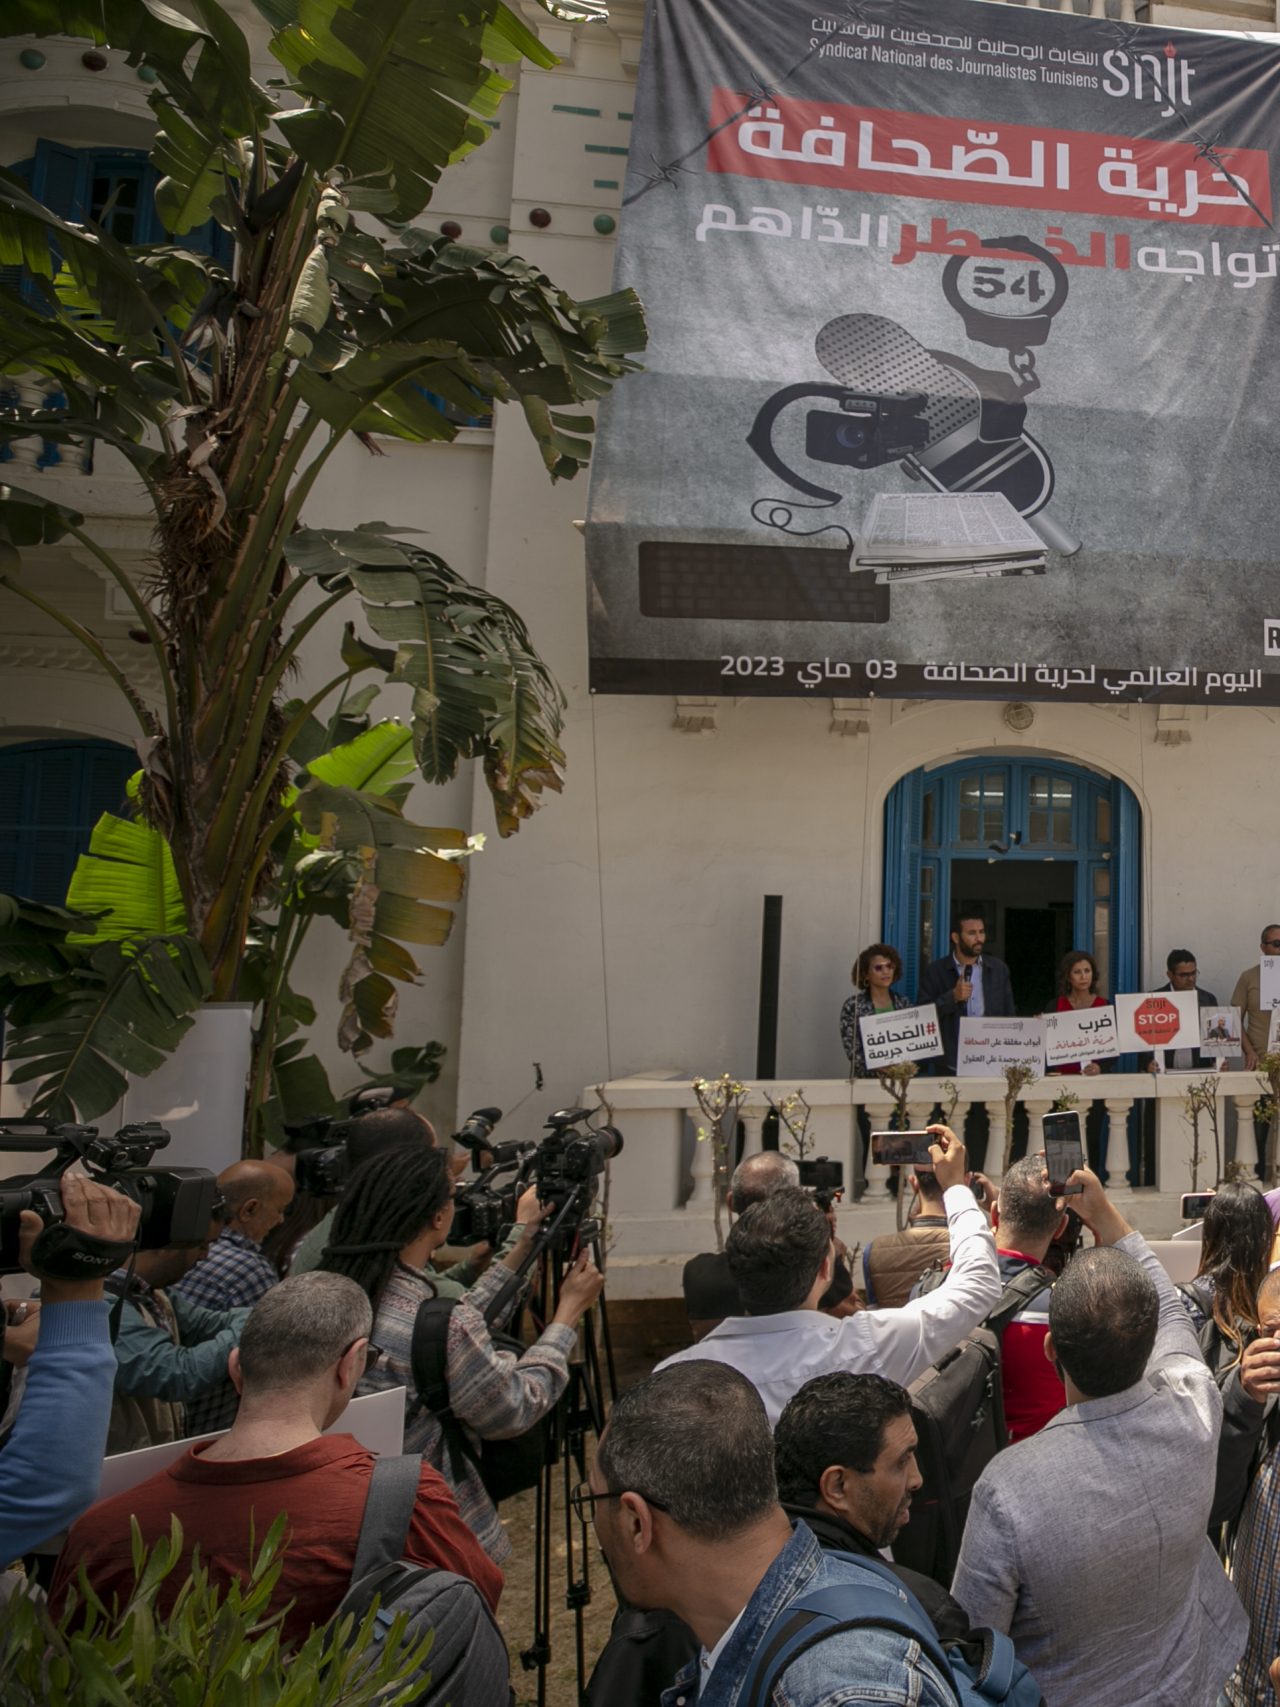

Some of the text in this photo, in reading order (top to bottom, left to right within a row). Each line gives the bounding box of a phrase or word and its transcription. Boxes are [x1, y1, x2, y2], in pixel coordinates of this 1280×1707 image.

[890, 27, 972, 52] للصحفيين
[977, 36, 1043, 61] الوطنية
[809, 37, 1098, 90] Syndicat National des Journalistes Tunisiens
[1049, 46, 1098, 67] النقابة
[1098, 146, 1249, 218] حرية
[1137, 241, 1280, 289] تواجه
[972, 267, 1046, 303] 54
[720, 655, 1263, 695] اليوم العالمي لحرية الصحافة 03 ماي 2023
[1078, 1014, 1112, 1034] ضرب
[1138, 1013, 1177, 1026] STOP
[868, 1036, 939, 1060] ليست جريمة
[990, 1037, 1002, 1048] على
[1023, 1036, 1041, 1047] أبواب
[72, 1251, 115, 1265] SONY
